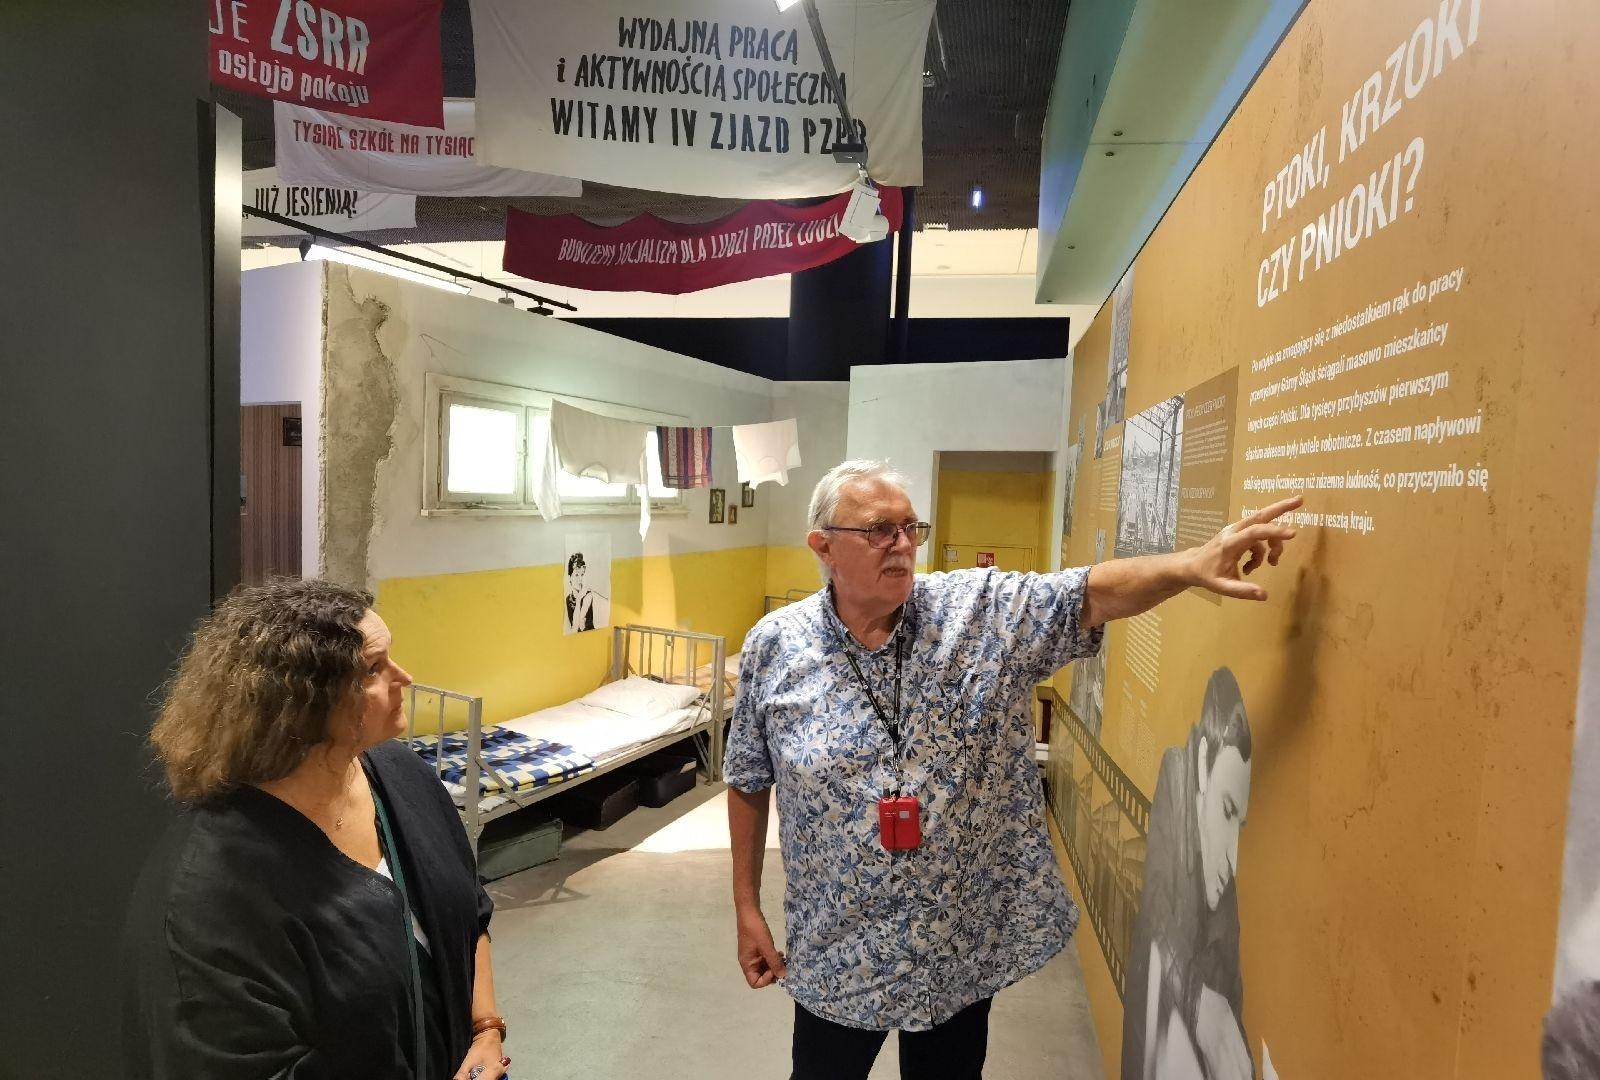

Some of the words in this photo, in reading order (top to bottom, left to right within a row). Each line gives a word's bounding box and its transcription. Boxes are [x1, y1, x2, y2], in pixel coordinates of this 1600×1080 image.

[271, 0, 370, 75] ZSRR
[619, 16, 720, 60] WYDAJNĄ
[729, 25, 799, 66] PRACĄ
[219, 50, 294, 94] ostoja
[301, 73, 369, 107] pokoju
[574, 54, 726, 102] AKTYWNOŚCIĄ
[293, 119, 344, 150] TYSIĄC
[350, 128, 394, 152] SZKÓŁ
[400, 134, 419, 154] NA
[425, 136, 475, 158] TYSIĄC
[551, 98, 656, 143] WITAMY
[671, 108, 697, 146] IV
[710, 112, 789, 154] ZJAZD
[1262, 125, 1329, 234] PTOKI,
[1338, 0, 1481, 164] KRZOKI
[285, 186, 358, 219] JESIENIĄ!
[1257, 235, 1296, 308] CZY
[1299, 136, 1425, 282] PNIOKI?
[558, 238, 616, 266] BUDUJEMY
[615, 238, 677, 266] SOCJALIZM
[681, 238, 706, 264] DLA
[711, 227, 748, 259] LUDZI
[753, 222, 796, 251] PRZEZ
[1314, 328, 1325, 346] się
[1331, 300, 1391, 338] niedostatkiem
[1392, 288, 1411, 314] rąk
[1412, 281, 1427, 303] do
[1428, 266, 1464, 302] pracy
[1346, 346, 1382, 371] masowo
[1383, 322, 1449, 359] mieszkańcy
[1299, 403, 1311, 419] Dla
[1311, 397, 1337, 421] tysięcy
[1337, 384, 1388, 416] przybyszów
[1388, 370, 1449, 406] pierwszym
[1299, 435, 1320, 454] hotele
[1320, 430, 1363, 452] robotnicze.
[1365, 427, 1373, 447] Z
[1373, 425, 1412, 446] czasem
[1413, 408, 1482, 445] napływowi
[1316, 471, 1345, 489] rdzenna
[1345, 468, 1381, 492] ludność,
[1383, 472, 1396, 489] co
[1397, 463, 1464, 493] przyczyniło
[1467, 462, 1489, 492] się
[1319, 513, 1324, 526] z
[1325, 512, 1349, 533] resztą
[1350, 510, 1375, 536] kraju.
